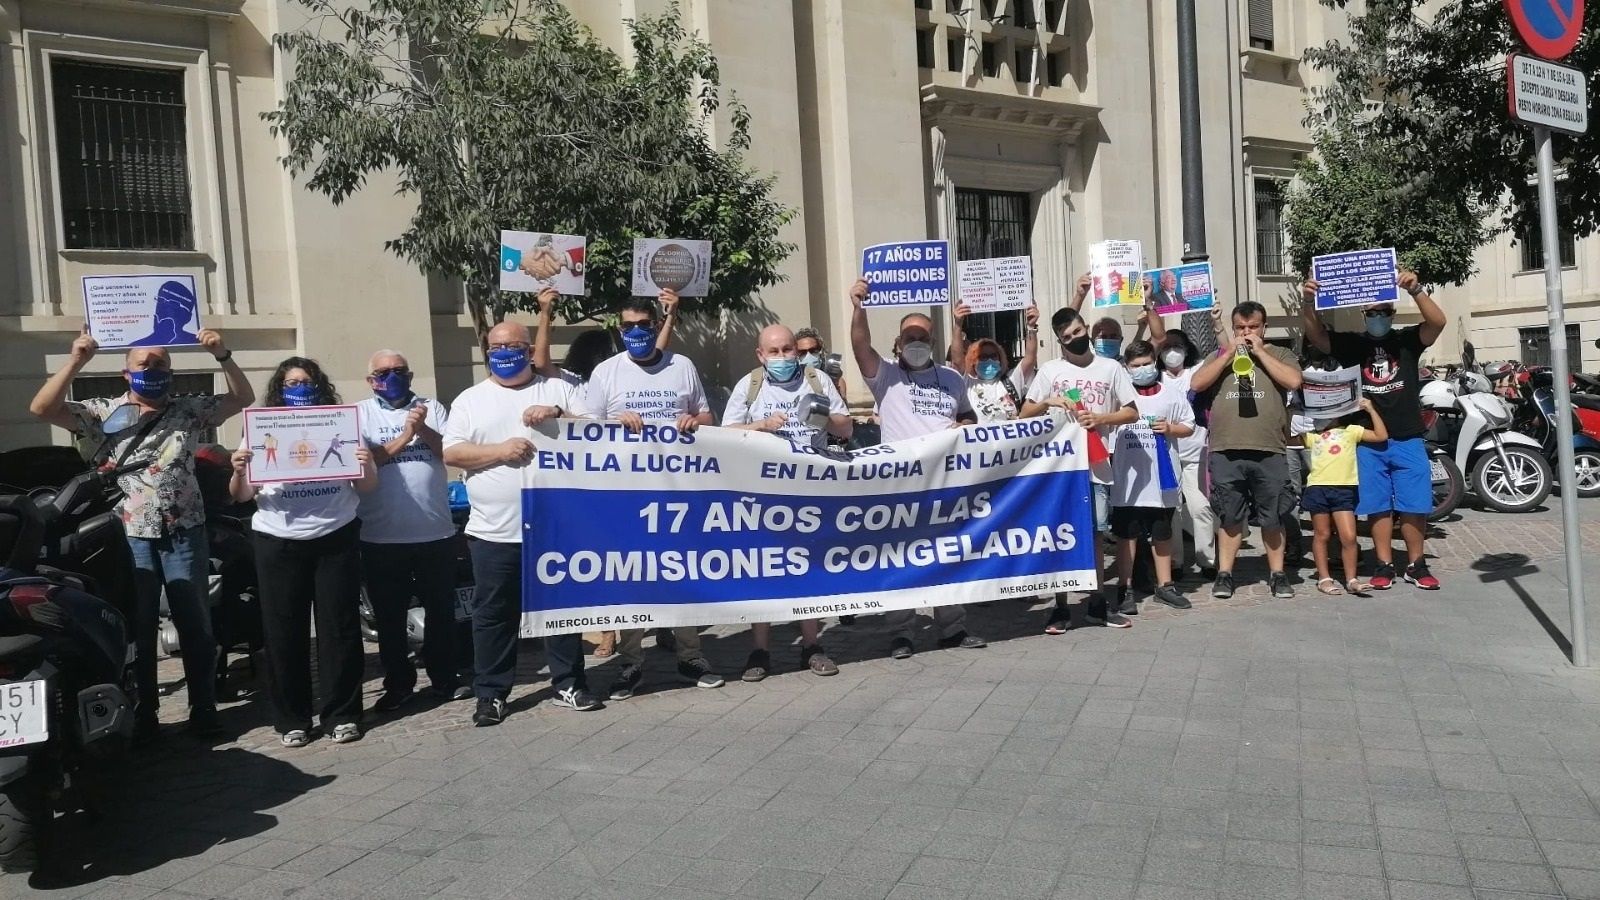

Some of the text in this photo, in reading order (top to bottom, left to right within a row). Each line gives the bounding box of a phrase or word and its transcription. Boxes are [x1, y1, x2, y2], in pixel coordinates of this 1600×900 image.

[1522, 62, 1528, 74] DE
[1550, 69, 1557, 81] DE
[1521, 81, 1579, 105] EXCEPTO CARGA Y DESCARGA
[1518, 98, 1583, 123] RESTO HORARIO ZONA REGULADA
[868, 245, 942, 264] 17 AÑOS DE
[1184, 243, 1191, 253] 2
[864, 267, 946, 284] COMISIONES
[863, 288, 949, 304] CONGELADAS
[638, 389, 662, 398] AÑOS
[663, 390, 678, 398] SIN
[1076, 379, 1111, 394] FAST
[625, 401, 663, 409] SUBIDAS
[638, 411, 677, 419] MISIONES
[567, 422, 696, 445] LOTEROS
[963, 418, 1054, 444] LOTEROS
[538, 451, 721, 474] EN LA LUCHA
[944, 439, 1074, 472] EN LA LUCHA
[761, 459, 923, 481] EN LA LUCHA
[281, 486, 341, 499] AUTÓNOMOS
[639, 490, 993, 534] 17 AÑOS CON LAS
[536, 522, 1077, 586] COMISIONES CONGELADAS
[999, 579, 1081, 595] MIERCOLES AL SOL
[792, 600, 884, 615] MIERCOLES AL SOL
[545, 613, 654, 630] MIERCOLES AL SOL
